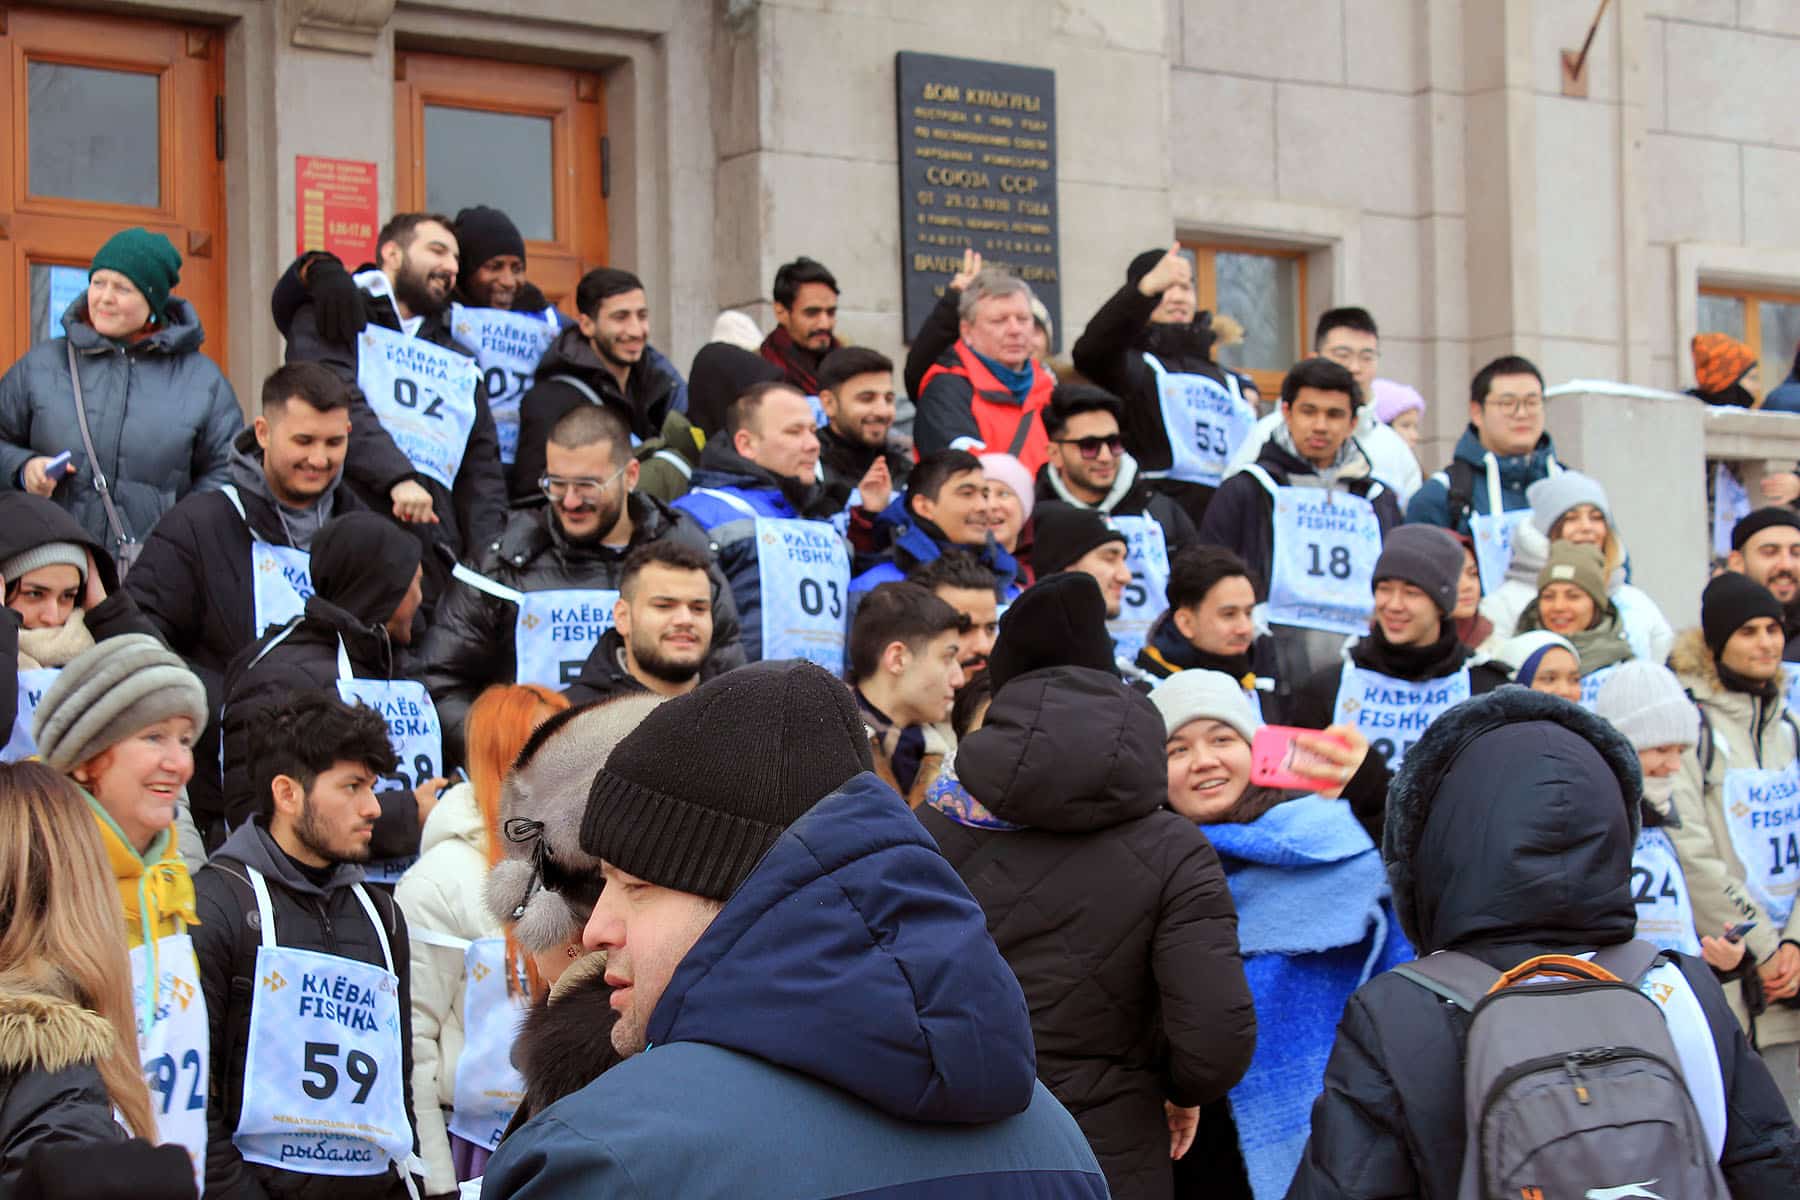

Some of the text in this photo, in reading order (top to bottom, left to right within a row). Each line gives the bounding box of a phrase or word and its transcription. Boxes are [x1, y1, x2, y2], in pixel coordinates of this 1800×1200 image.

[927, 166, 1038, 193] СОЮЗА ССР
[394, 378, 445, 421] 02
[1195, 420, 1229, 457] 53
[1306, 543, 1352, 580] 18
[799, 577, 841, 619] 03
[551, 624, 609, 642] FISH
[1769, 832, 1800, 876] 14
[1630, 865, 1678, 906] 24
[299, 996, 379, 1032] FISHKA
[143, 1048, 205, 1115] 92
[301, 1040, 379, 1105] 59
[280, 1139, 373, 1163] рыбалка
